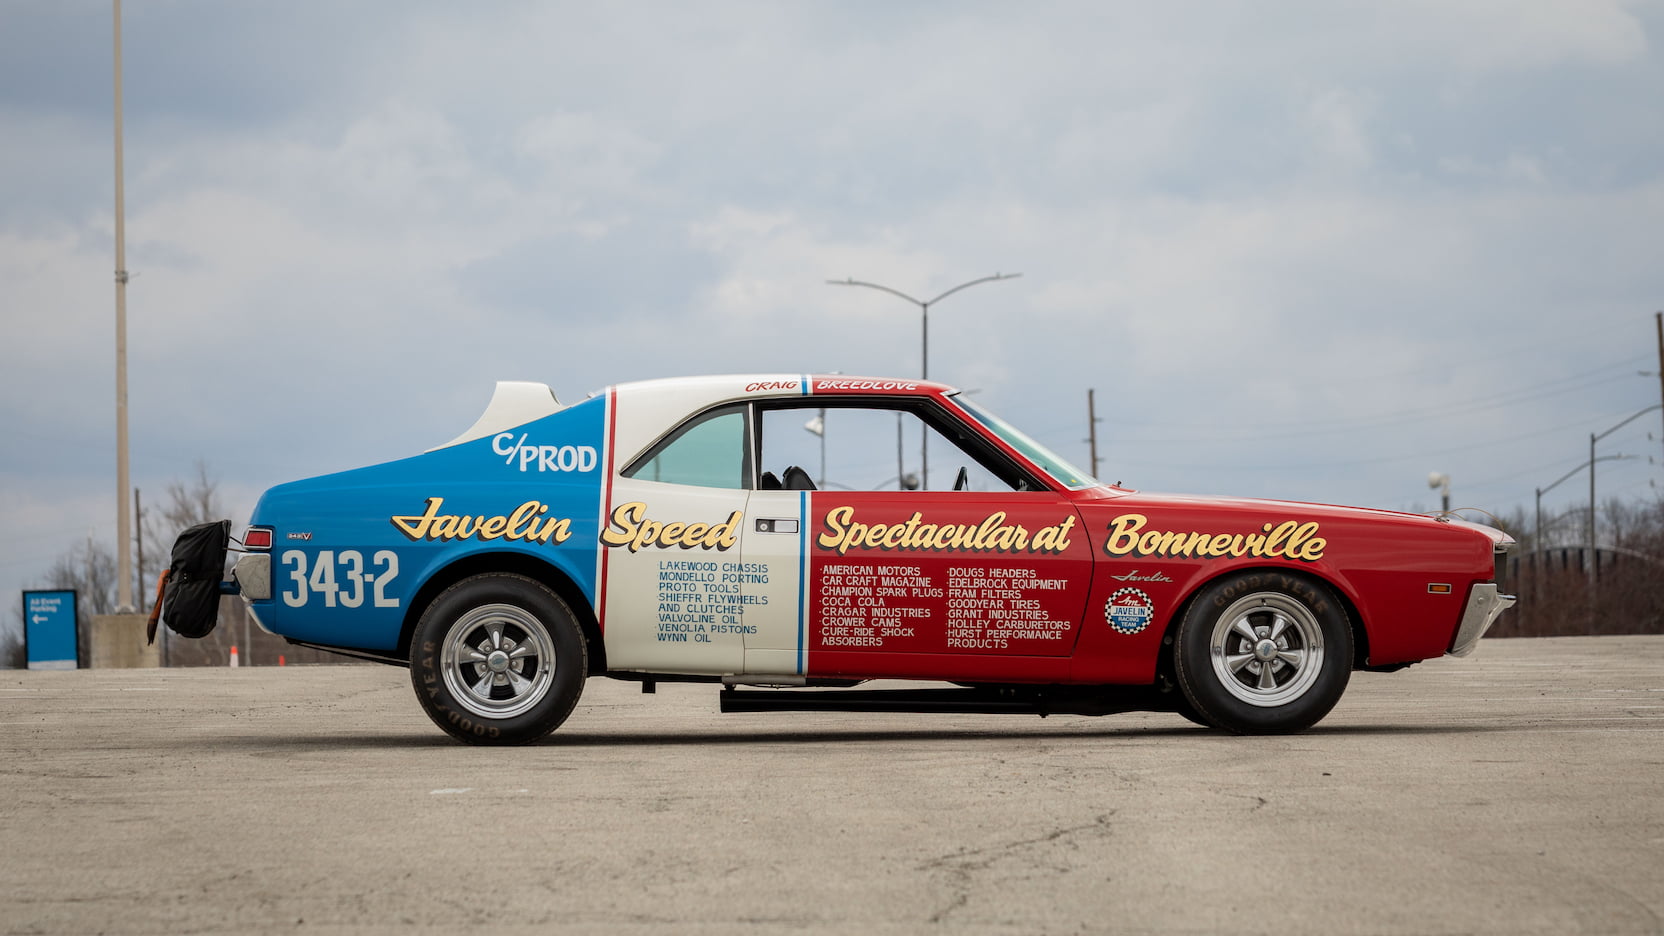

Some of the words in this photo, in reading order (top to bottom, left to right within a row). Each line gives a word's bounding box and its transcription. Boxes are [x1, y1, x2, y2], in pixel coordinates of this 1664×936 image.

[745, 381, 799, 392] CRAIG
[816, 380, 919, 390] BREEDLOVE
[391, 497, 573, 545] Javelin
[600, 501, 743, 553] Speed
[817, 506, 1030, 556] Spectacular
[1028, 514, 1076, 554] at
[1104, 513, 1328, 561] Bonneville
[659, 561, 718, 572] LAKEWOOD
[722, 563, 768, 573] CHASSIS
[823, 565, 873, 575] AMERICAN
[878, 566, 920, 576] MOTORS
[659, 572, 715, 582] MONDELLO
[722, 574, 769, 583] PORTING
[949, 568, 984, 577] DOUGS
[989, 568, 1036, 578] HEADERS
[1110, 570, 1173, 582] Javelin
[281, 550, 400, 608] 343-2
[823, 576, 842, 586] CAR
[846, 576, 877, 586] CRAFT
[881, 577, 931, 587] MAGAZINE
[949, 578, 1007, 588] EDELBROCK
[1012, 580, 1068, 590] EQUIPMENT
[659, 583, 696, 592] PROTO
[704, 584, 739, 593] TOOLS
[822, 586, 872, 596] CHAMPION
[876, 588, 907, 597] SPARK
[912, 588, 943, 597] PLUGS
[948, 589, 976, 598] FRAM
[981, 590, 1021, 599] FILTERS
[708, 594, 768, 605] FLYWHEELS
[822, 597, 851, 606] COCA
[858, 598, 885, 607] COLA
[948, 599, 1004, 609] GOODYEAR
[1010, 600, 1040, 609] TIRES
[658, 603, 680, 612] AND
[687, 604, 744, 614] CLUTCHES
[822, 607, 867, 616] CRAGAR
[871, 608, 931, 617] INDUSTRIES
[1114, 607, 1145, 615] JAVELIN
[659, 614, 715, 623] VALVOLINE
[722, 615, 738, 624] OIL
[948, 609, 983, 618] GRANT
[988, 610, 1049, 620] INDUSTRIES
[822, 617, 865, 626] CROWER
[871, 618, 901, 627] CAMS
[948, 619, 990, 628] HOLLEY
[996, 620, 1071, 630] CARBURETORS
[659, 624, 705, 632] VENOLIA
[711, 625, 757, 634] PISTONS
[821, 628, 874, 636] CURE-RIDE
[881, 628, 914, 636] SHOCK
[947, 629, 982, 638] HURST
[987, 630, 1062, 639] PERFORMANCE
[657, 633, 687, 642] WYNN
[695, 634, 711, 642] OIL
[822, 637, 883, 646] ABSORBERS
[947, 639, 1008, 648] PRODUCTS
